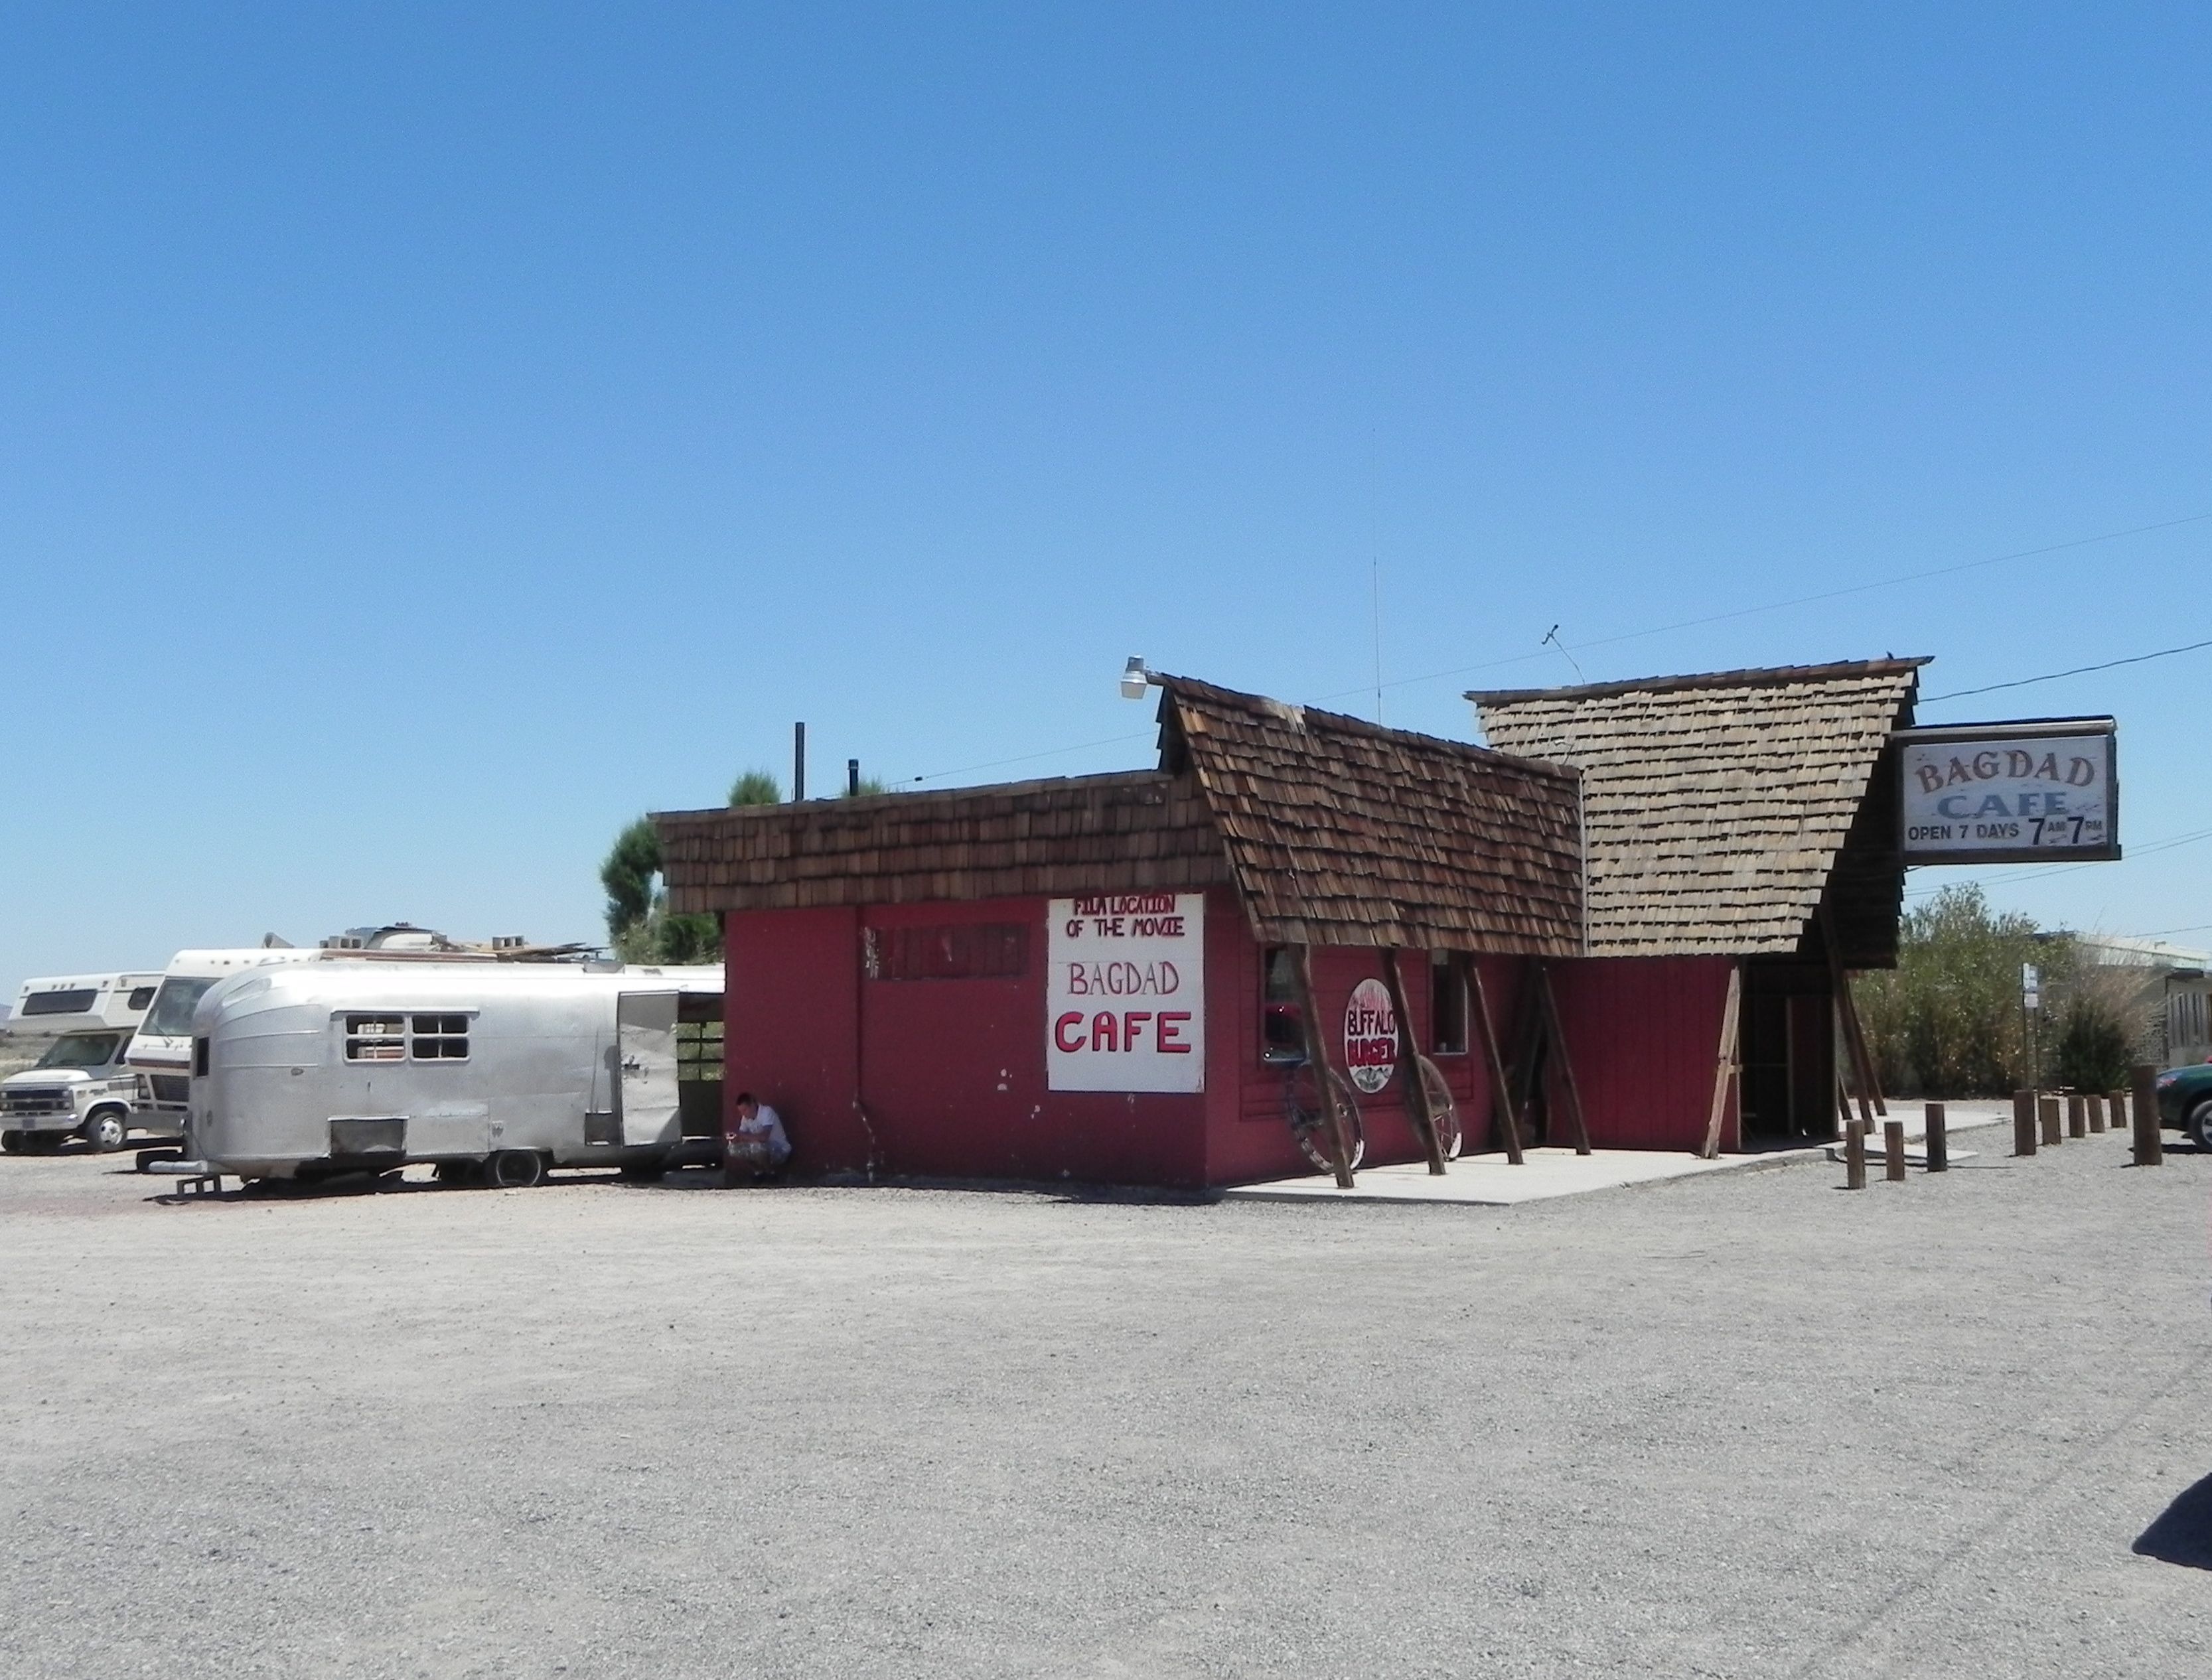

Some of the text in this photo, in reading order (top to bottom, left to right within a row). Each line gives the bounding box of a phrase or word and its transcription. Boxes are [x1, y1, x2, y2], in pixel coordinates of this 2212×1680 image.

[1915, 749, 2095, 794] BAGDAD
[1937, 792, 2069, 819] CAFE
[1908, 825, 1951, 841] OPEN
[1958, 825, 1969, 839] 7
[1976, 823, 2020, 839] DAYS
[1074, 894, 1176, 916] FILM LOCATION
[1066, 916, 1185, 938] OF THE MOVIE
[1066, 961, 1180, 996] BAGDAD
[1055, 1011, 1192, 1054] CAFE
[1347, 1009, 1396, 1036] BUFFALO
[1347, 1037, 1396, 1068] BURGER
